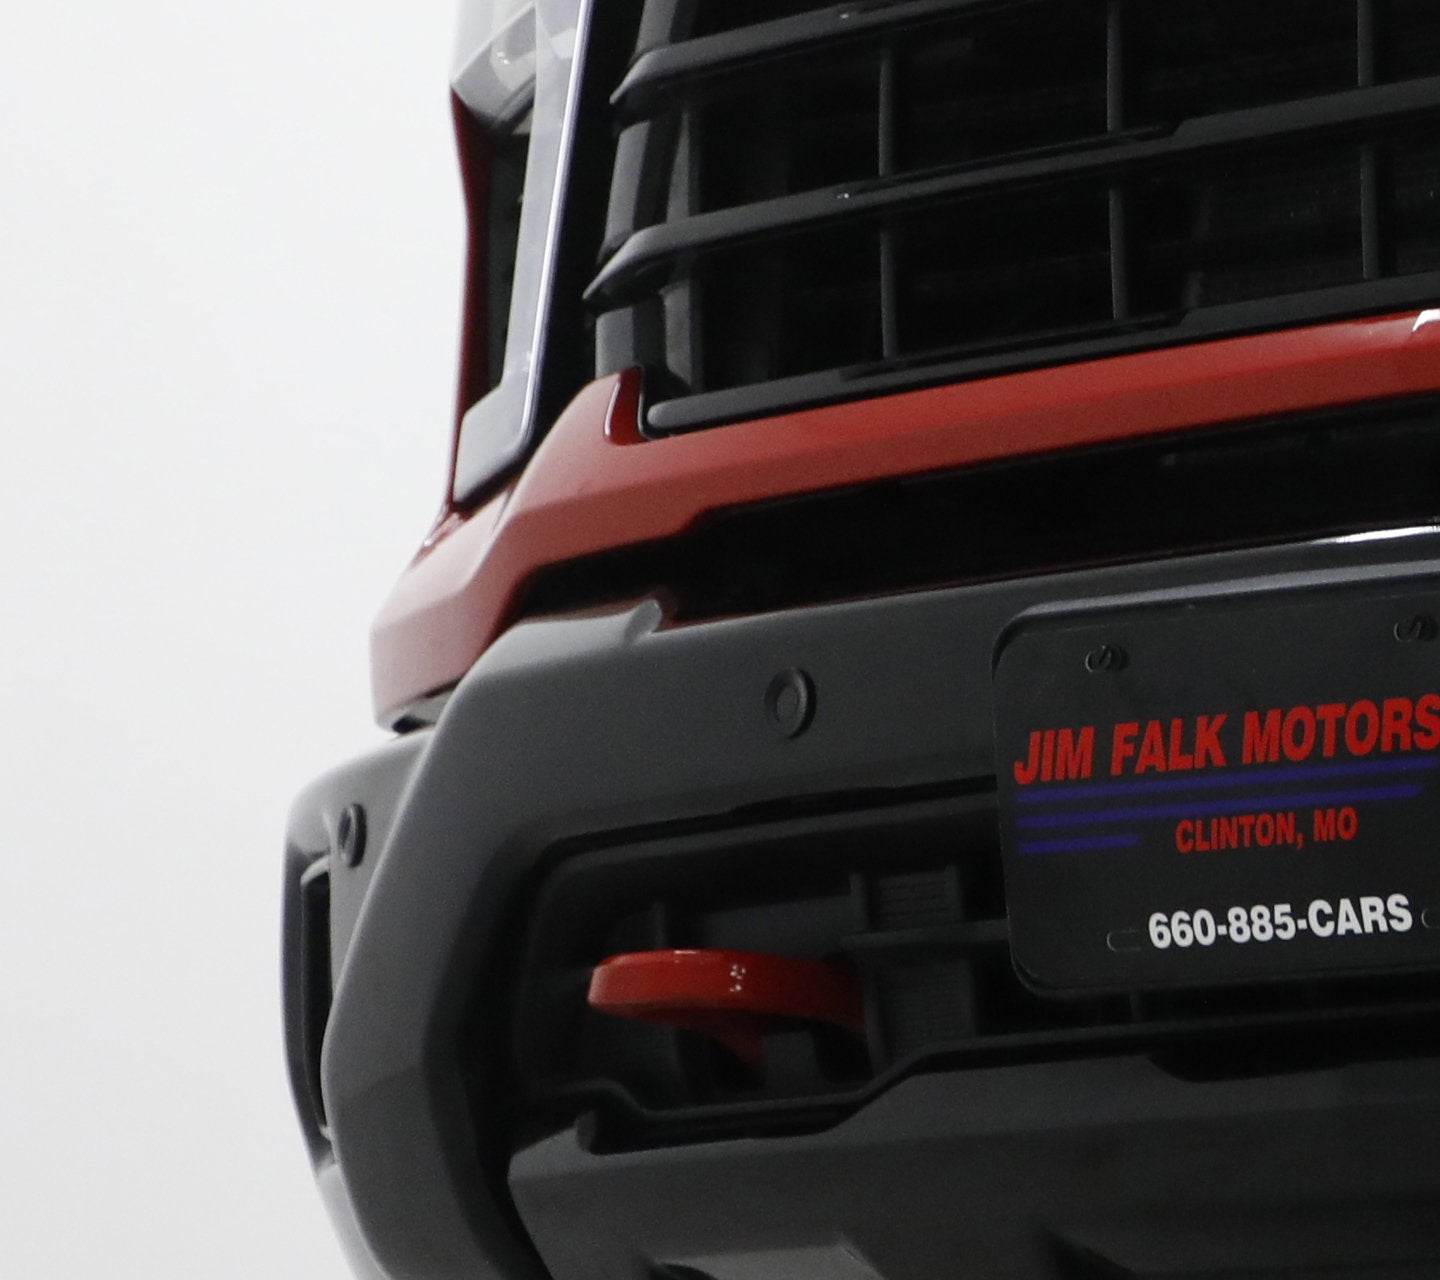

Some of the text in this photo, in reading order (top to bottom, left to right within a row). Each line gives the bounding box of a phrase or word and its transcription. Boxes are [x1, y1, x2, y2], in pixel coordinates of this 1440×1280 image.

[1013, 726, 1095, 785] JIM
[1110, 714, 1228, 776] FALK
[1174, 806, 1358, 854] CLINTON, MO
[1149, 893, 1413, 949] 660-885-CARS
